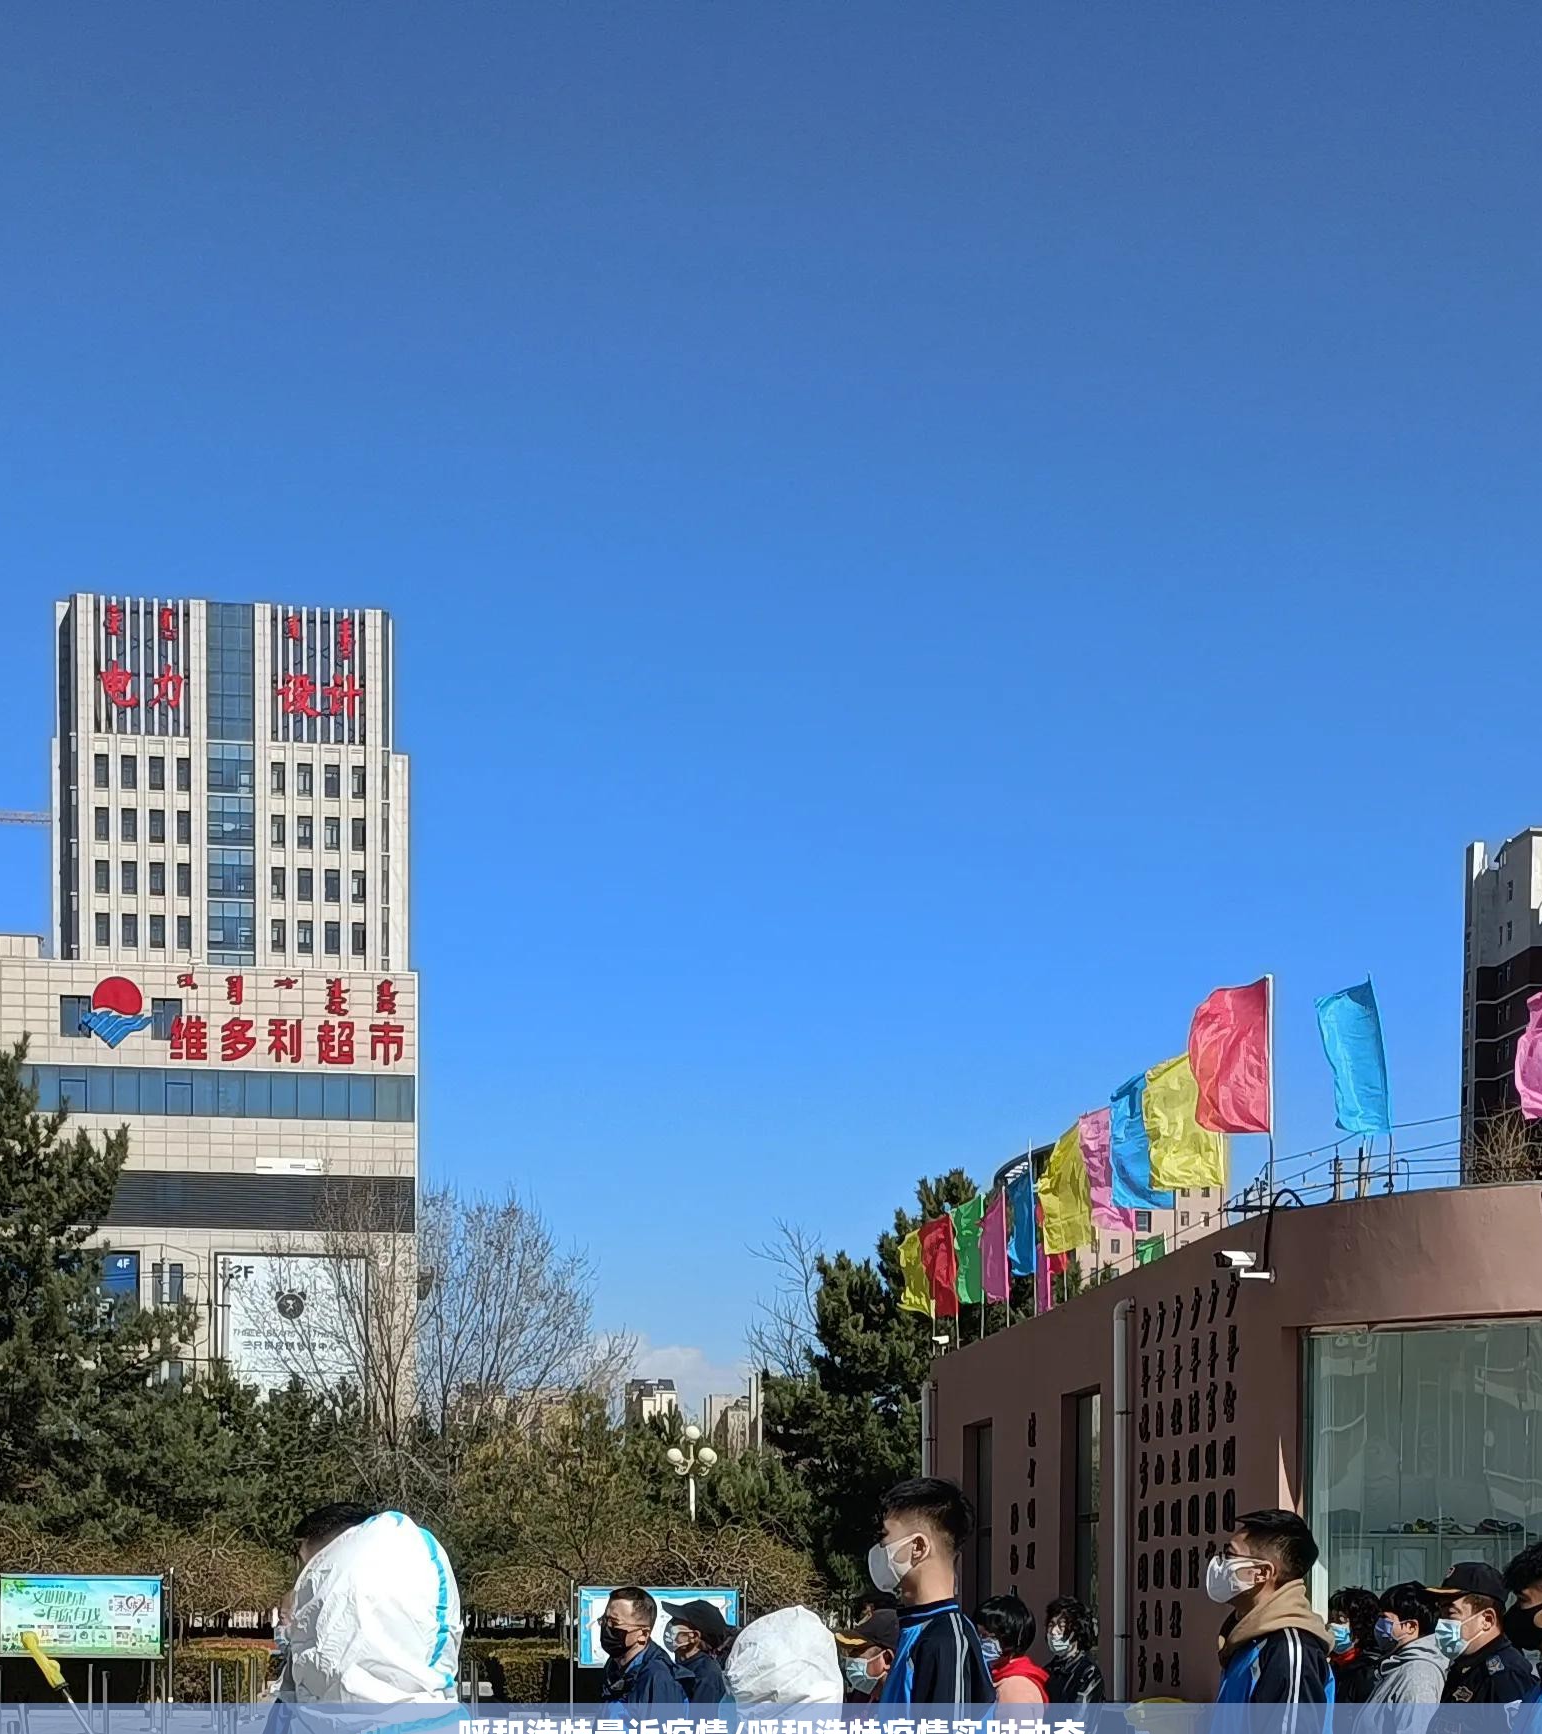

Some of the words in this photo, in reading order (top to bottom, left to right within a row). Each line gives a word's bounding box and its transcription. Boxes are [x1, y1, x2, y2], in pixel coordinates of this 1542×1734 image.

[99, 660, 183, 709] 电力
[275, 673, 364, 720] 设计
[169, 1015, 405, 1067] 维多利超市
[116, 1258, 130, 1269] 4F
